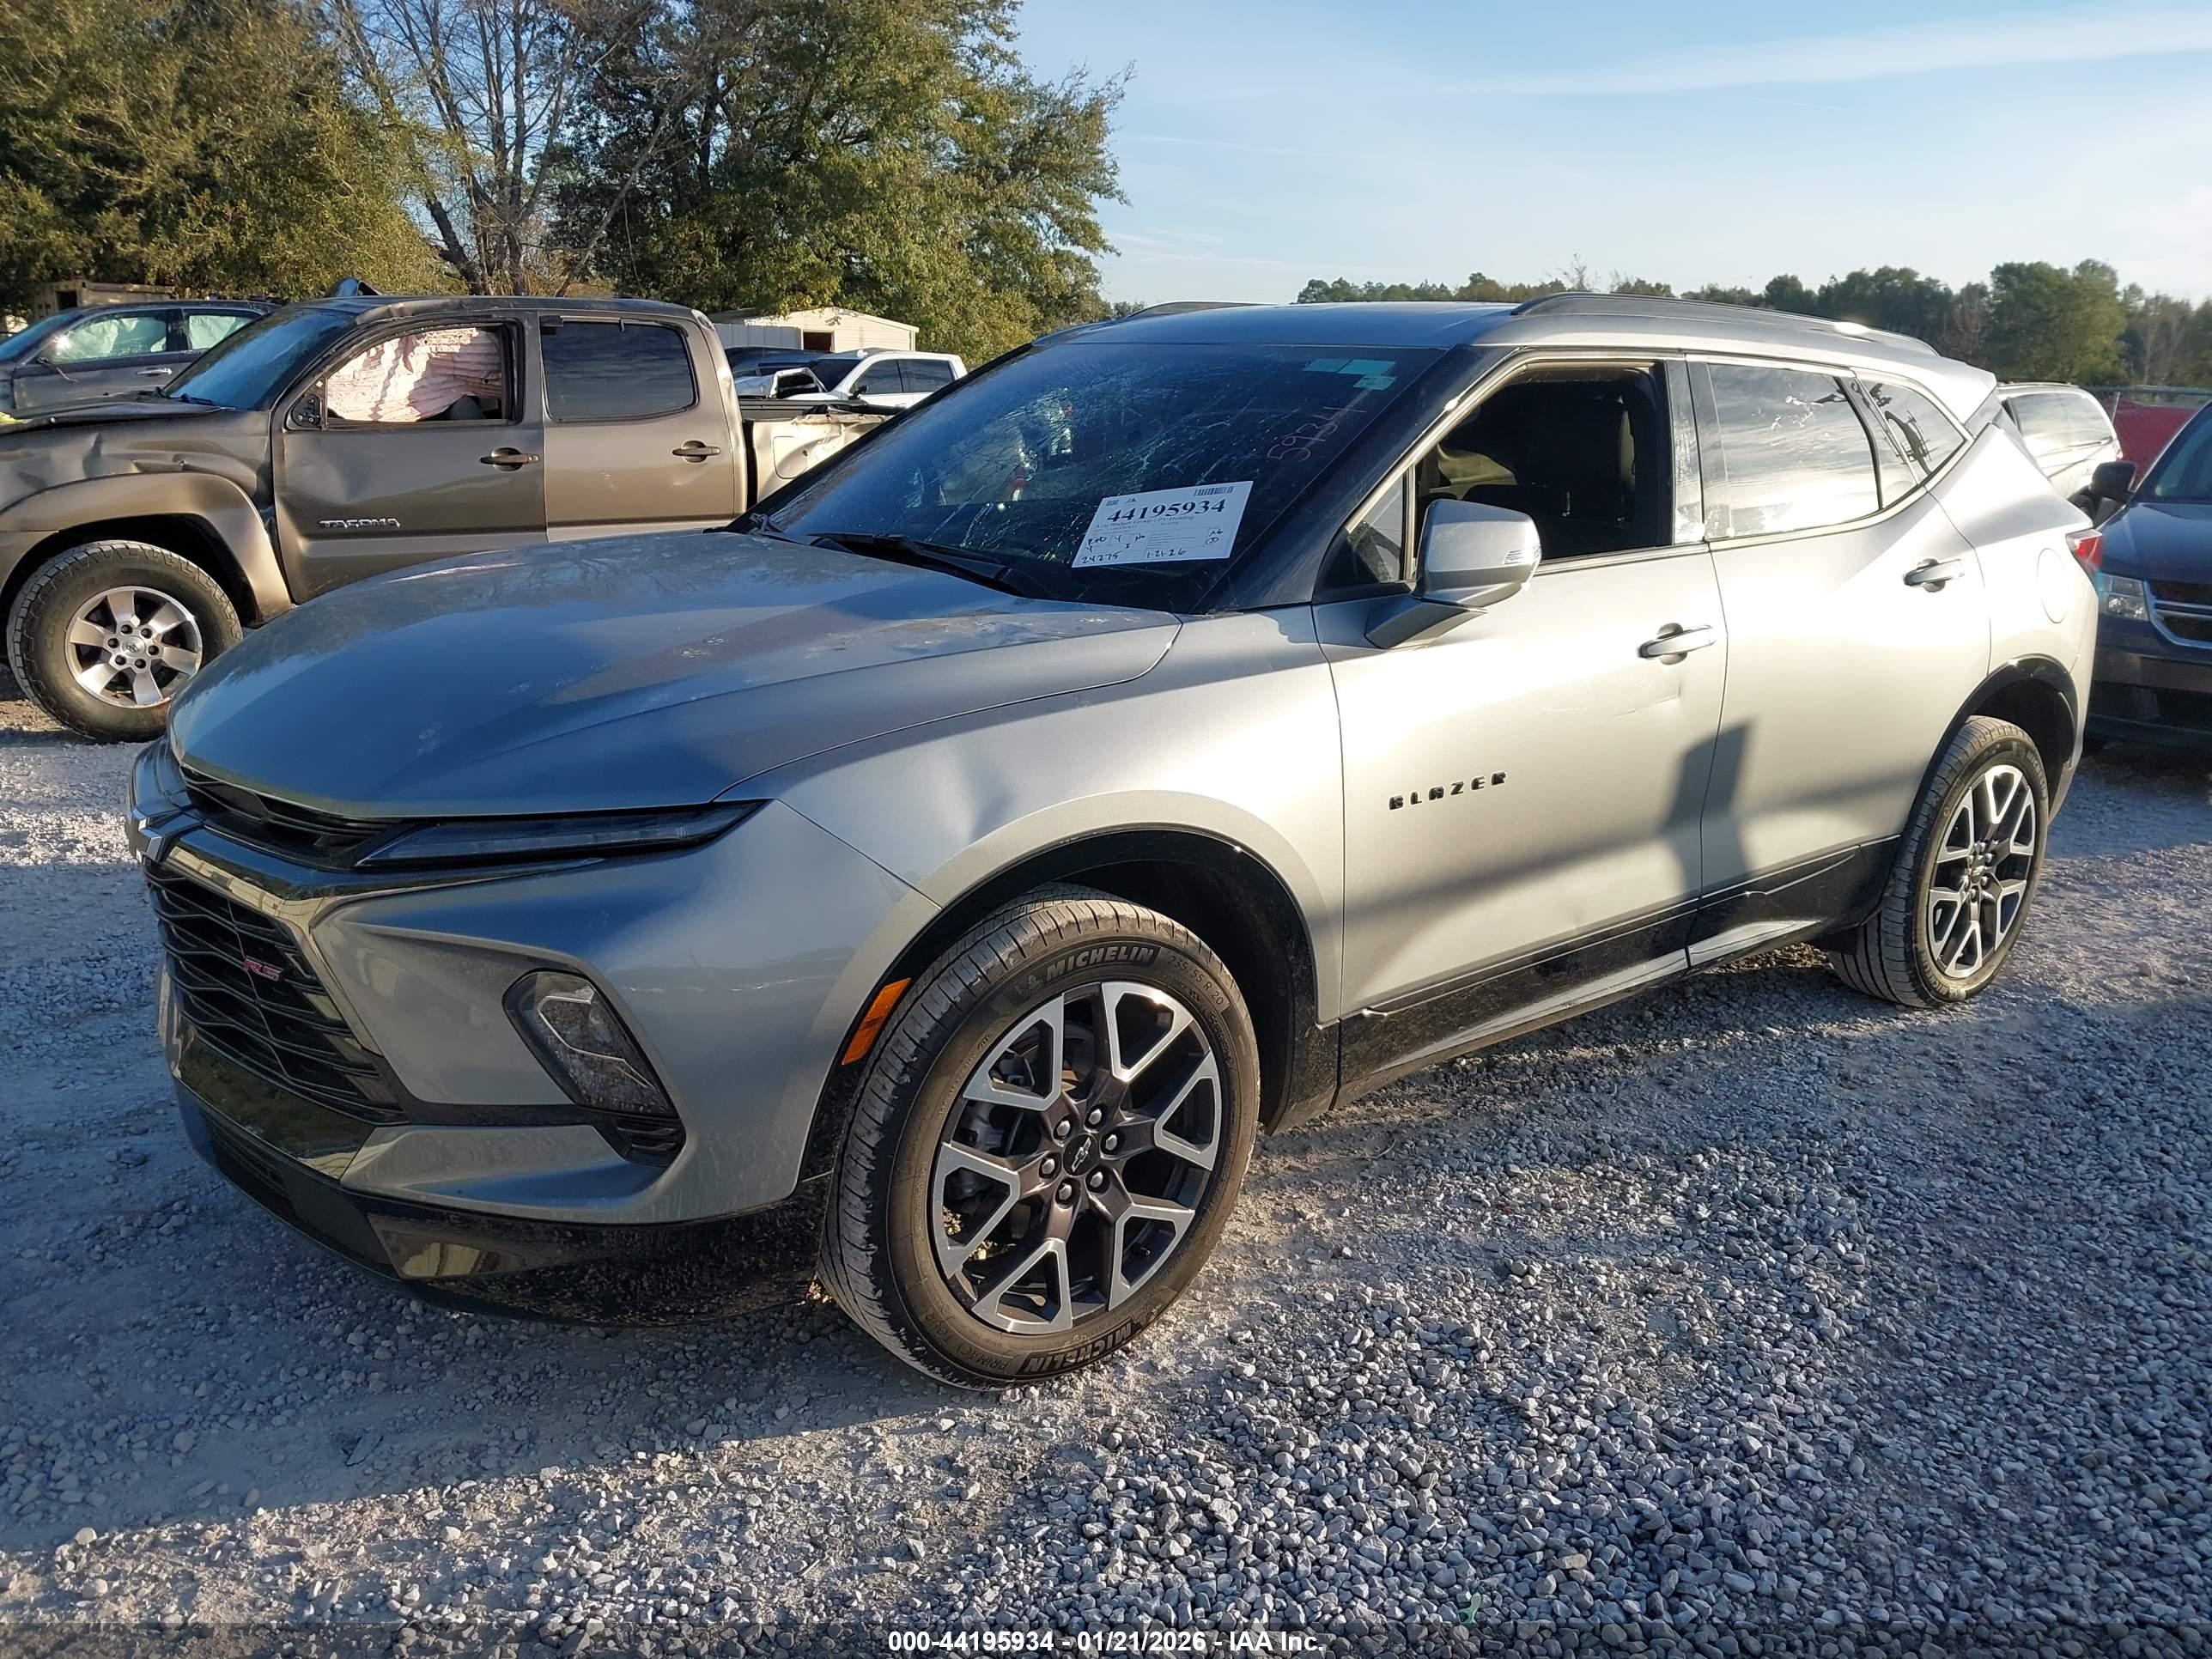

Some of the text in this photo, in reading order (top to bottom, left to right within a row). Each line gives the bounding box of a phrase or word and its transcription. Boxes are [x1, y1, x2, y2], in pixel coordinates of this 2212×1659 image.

[318, 518, 401, 529] TACOMA
[1106, 498, 1226, 523] 44195934
[1389, 771, 1506, 811] BLAZER
[243, 957, 282, 981] RS
[1046, 945, 1154, 981] MICHELIN
[1167, 956, 1204, 983] 235/55
[1029, 1322, 1132, 1372] MICHELIN
